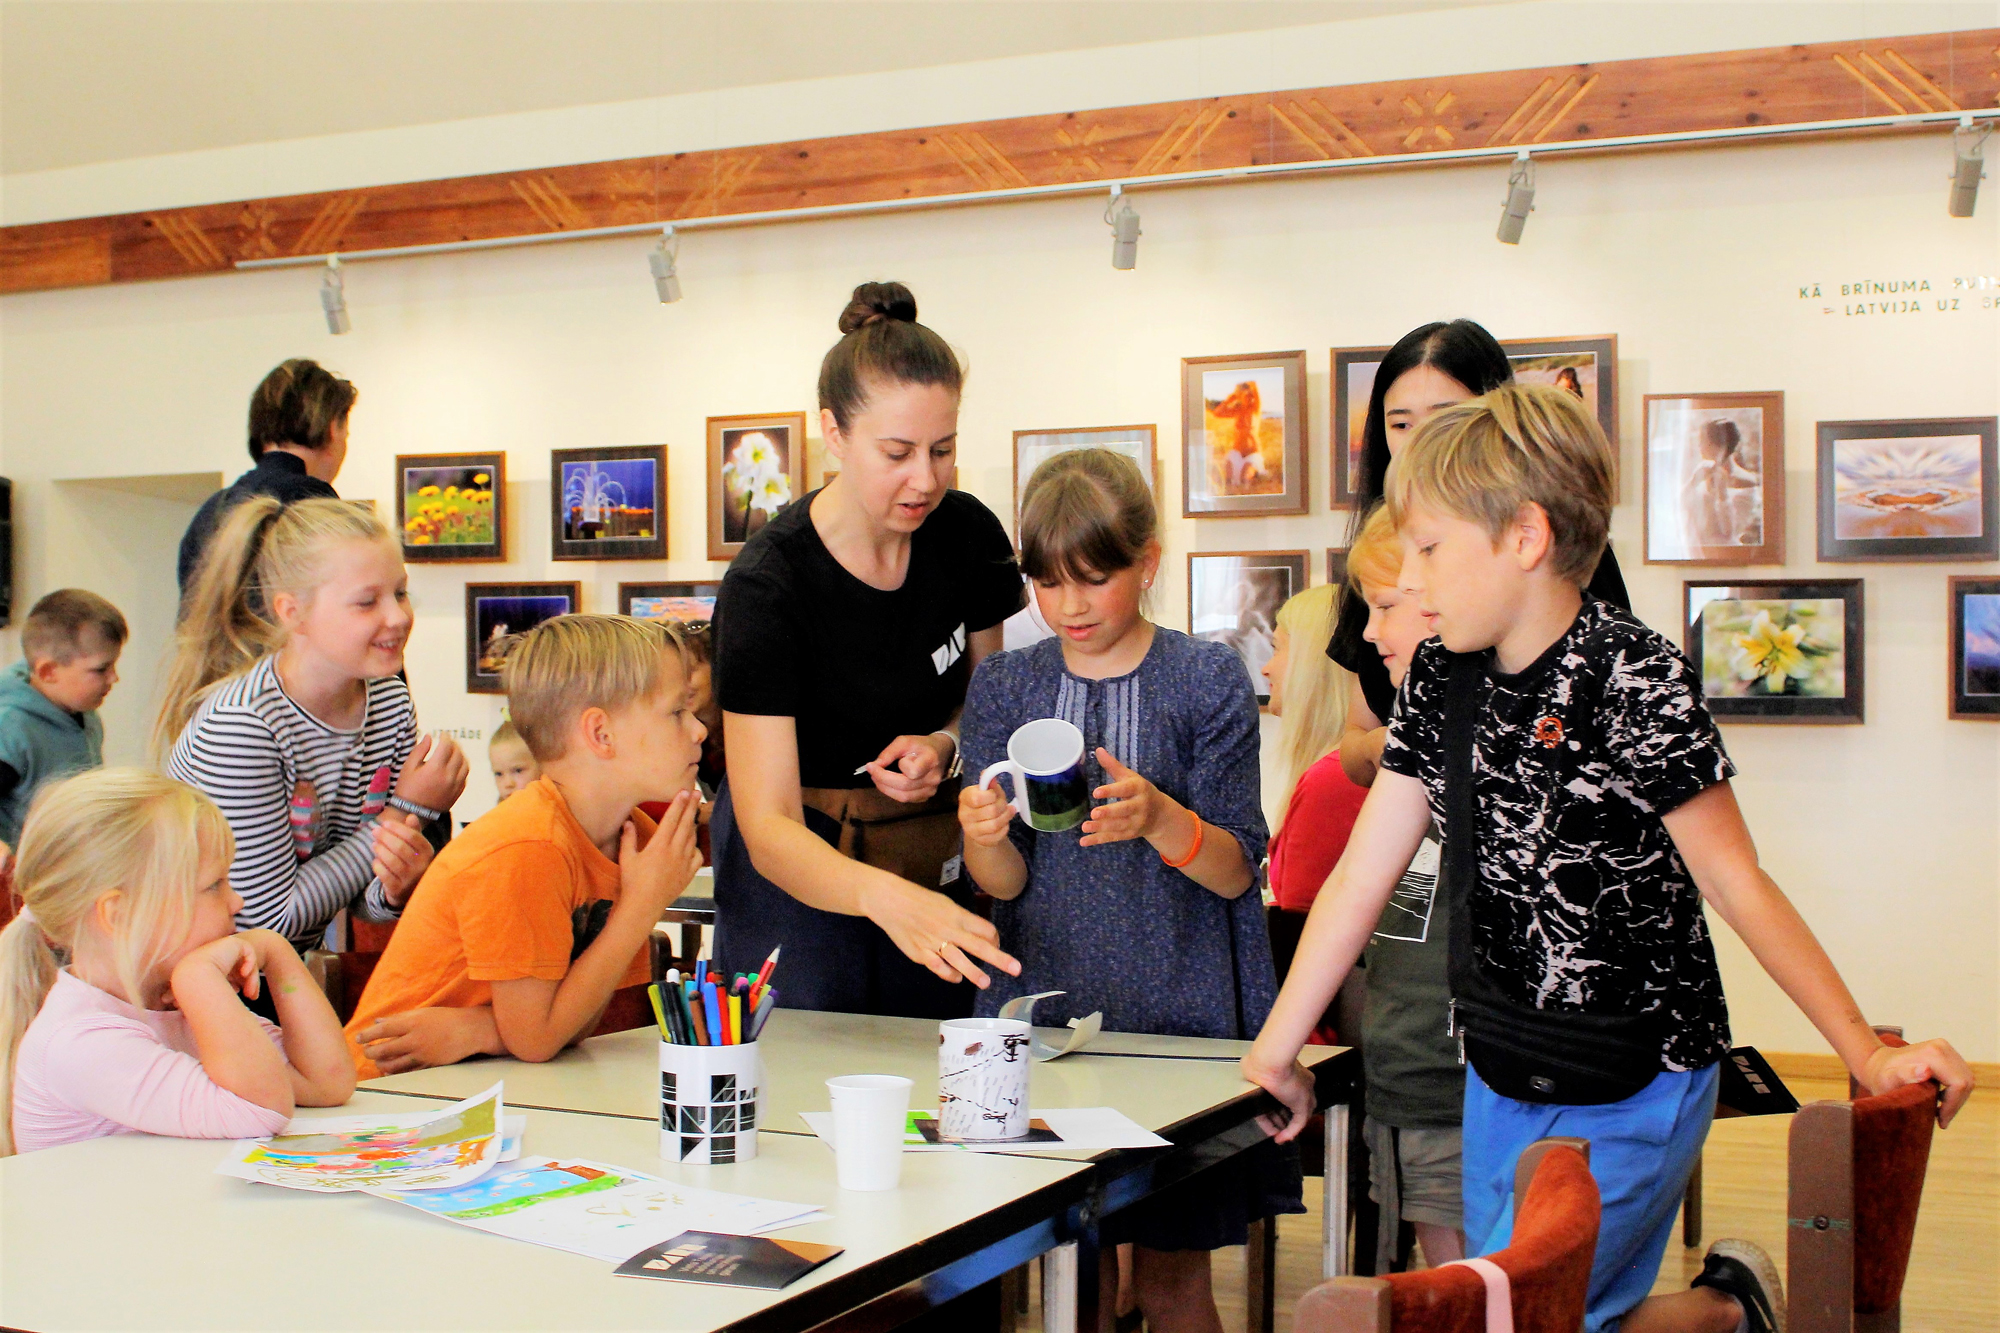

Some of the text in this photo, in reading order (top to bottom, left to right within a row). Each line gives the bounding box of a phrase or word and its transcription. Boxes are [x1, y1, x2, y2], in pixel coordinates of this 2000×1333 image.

[1799, 283, 1822, 299] KĀ
[1841, 280, 1931, 297] BRĪNUMA
[1846, 301, 1921, 316] LATVIJA
[1937, 299, 1960, 312] UZ
